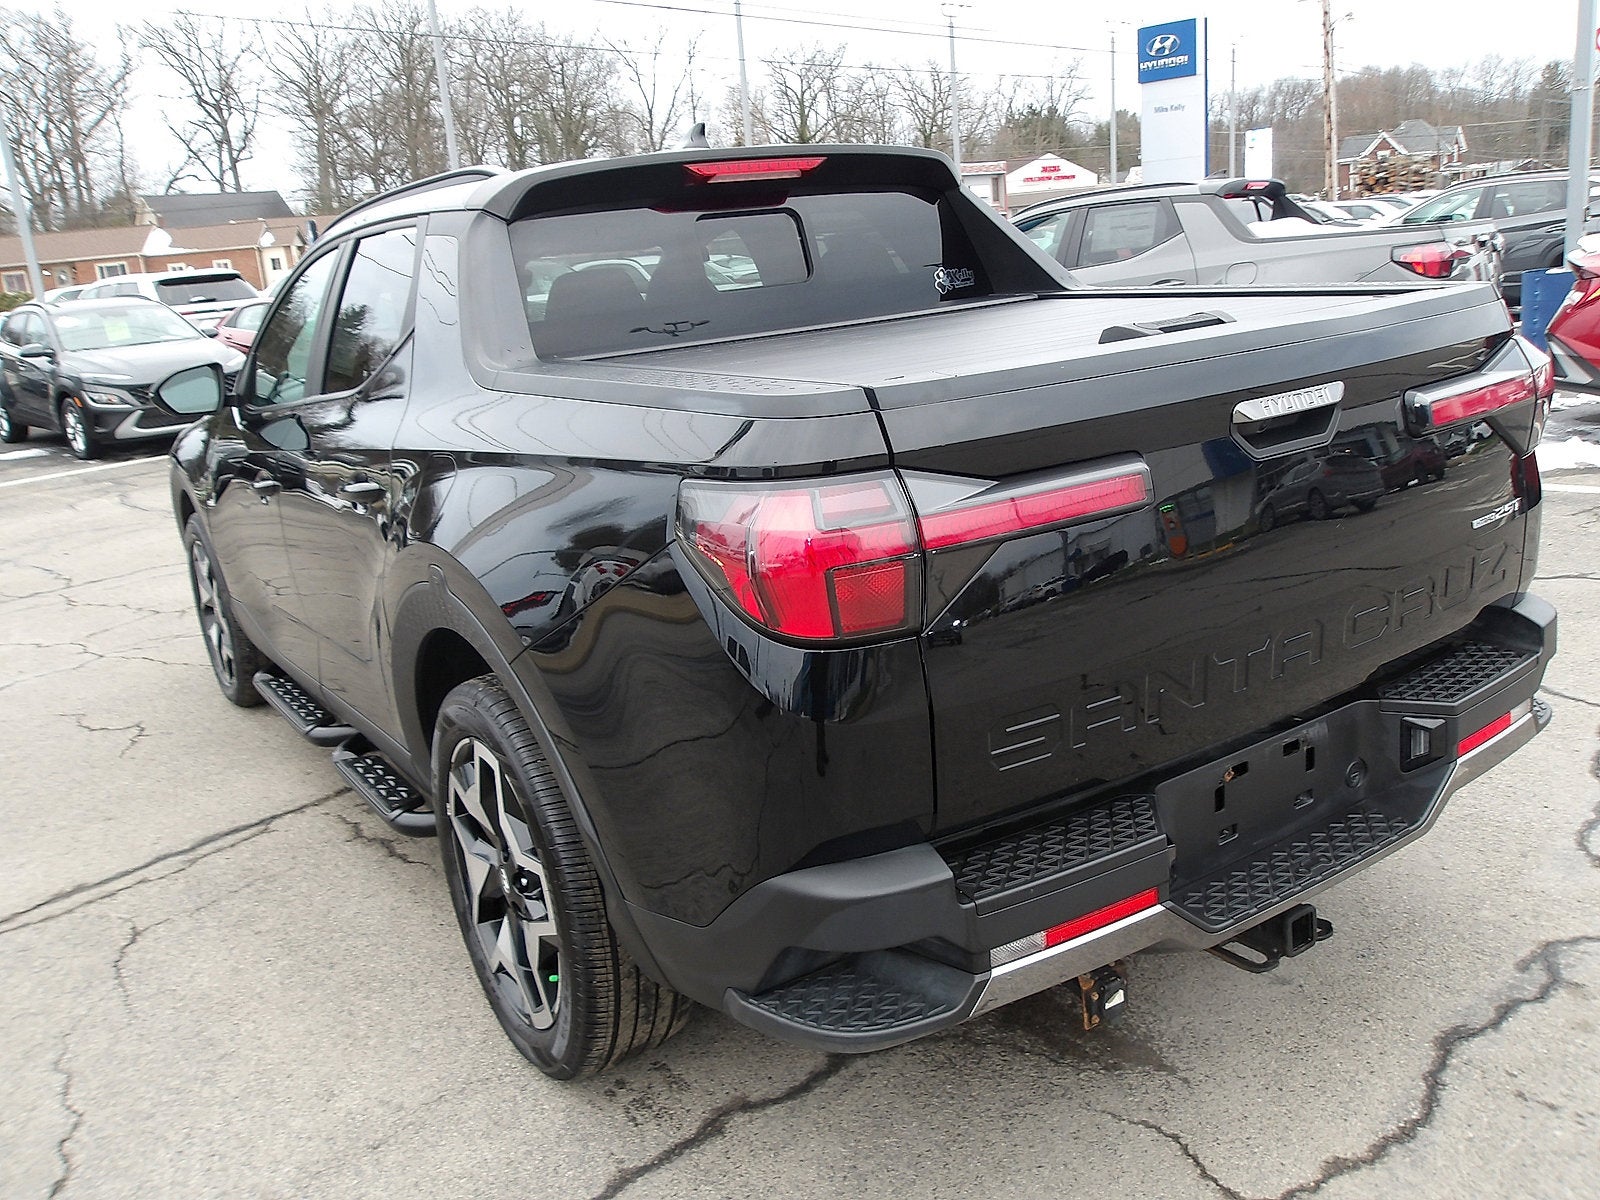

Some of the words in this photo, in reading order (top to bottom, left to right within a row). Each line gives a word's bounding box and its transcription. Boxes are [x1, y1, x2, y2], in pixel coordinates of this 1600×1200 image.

[1139, 54, 1189, 71] HYUNDAI
[1259, 385, 1333, 417] HYUNDAI
[987, 618, 1324, 771] SANTA
[1342, 541, 1508, 649] CRUZ
